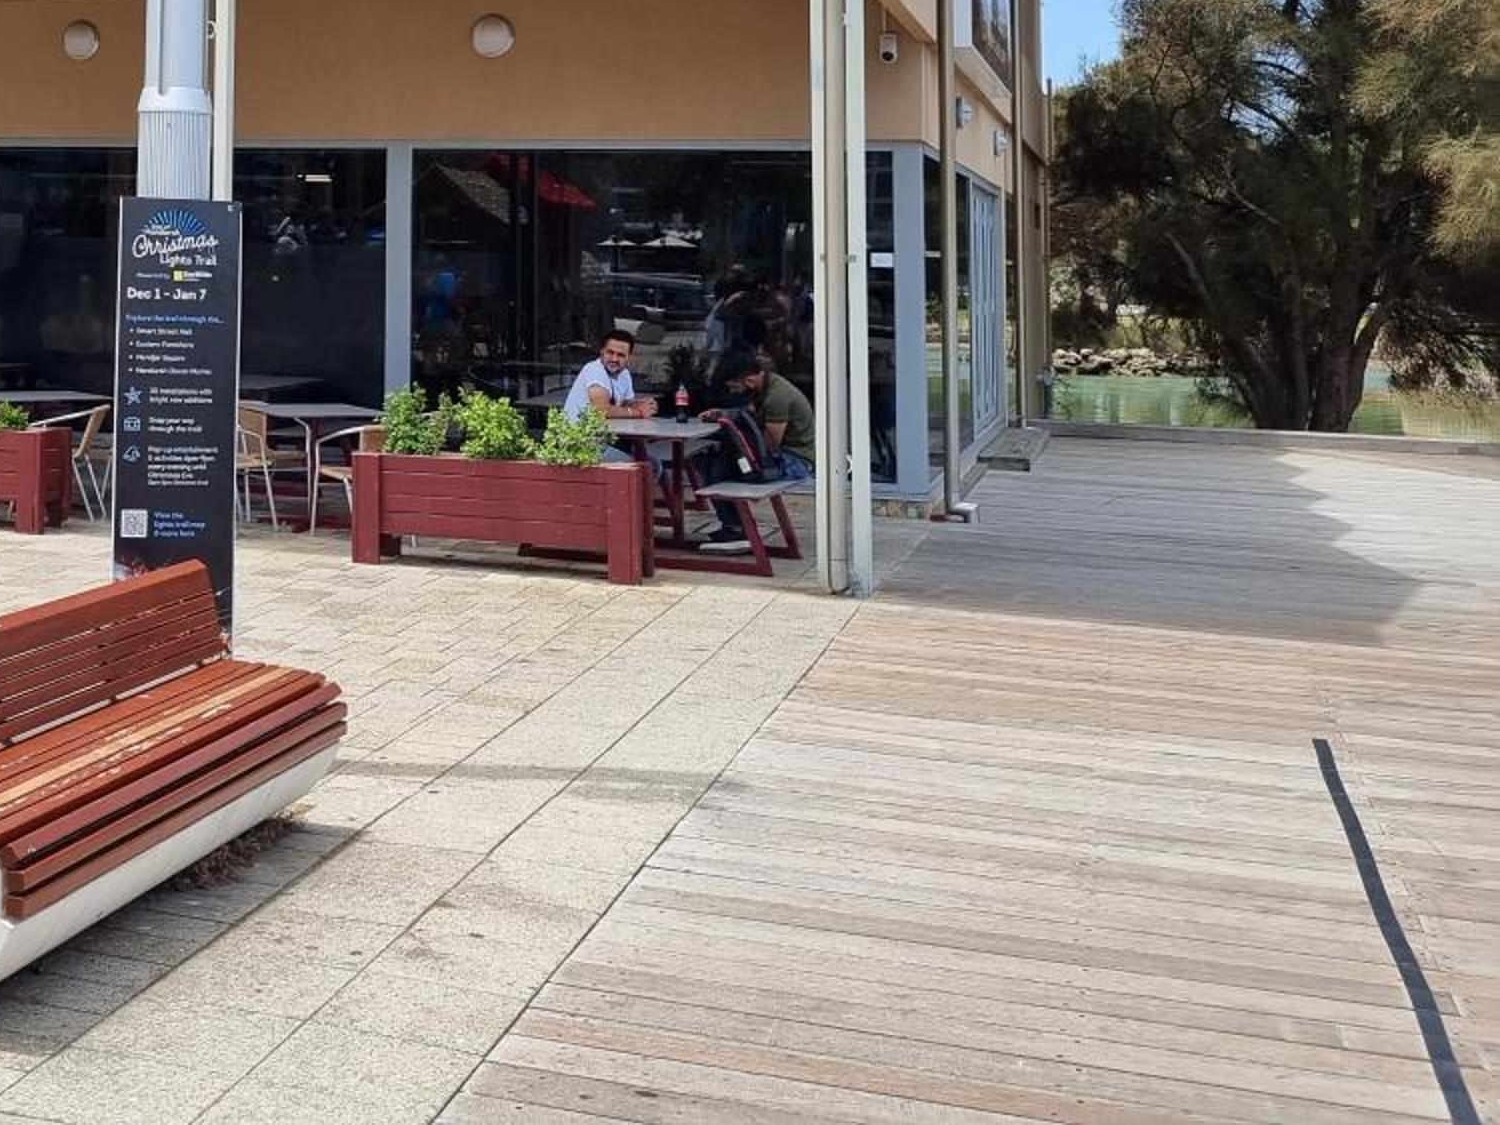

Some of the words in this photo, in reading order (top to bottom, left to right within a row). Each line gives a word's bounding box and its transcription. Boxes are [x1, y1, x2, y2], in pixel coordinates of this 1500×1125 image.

[132, 234, 219, 258] Christmas
[160, 253, 192, 267] Lights
[195, 255, 217, 266] Trail
[127, 287, 152, 300] Dec
[154, 288, 161, 300] 1
[172, 289, 196, 300] Jan
[199, 289, 207, 300] 7
